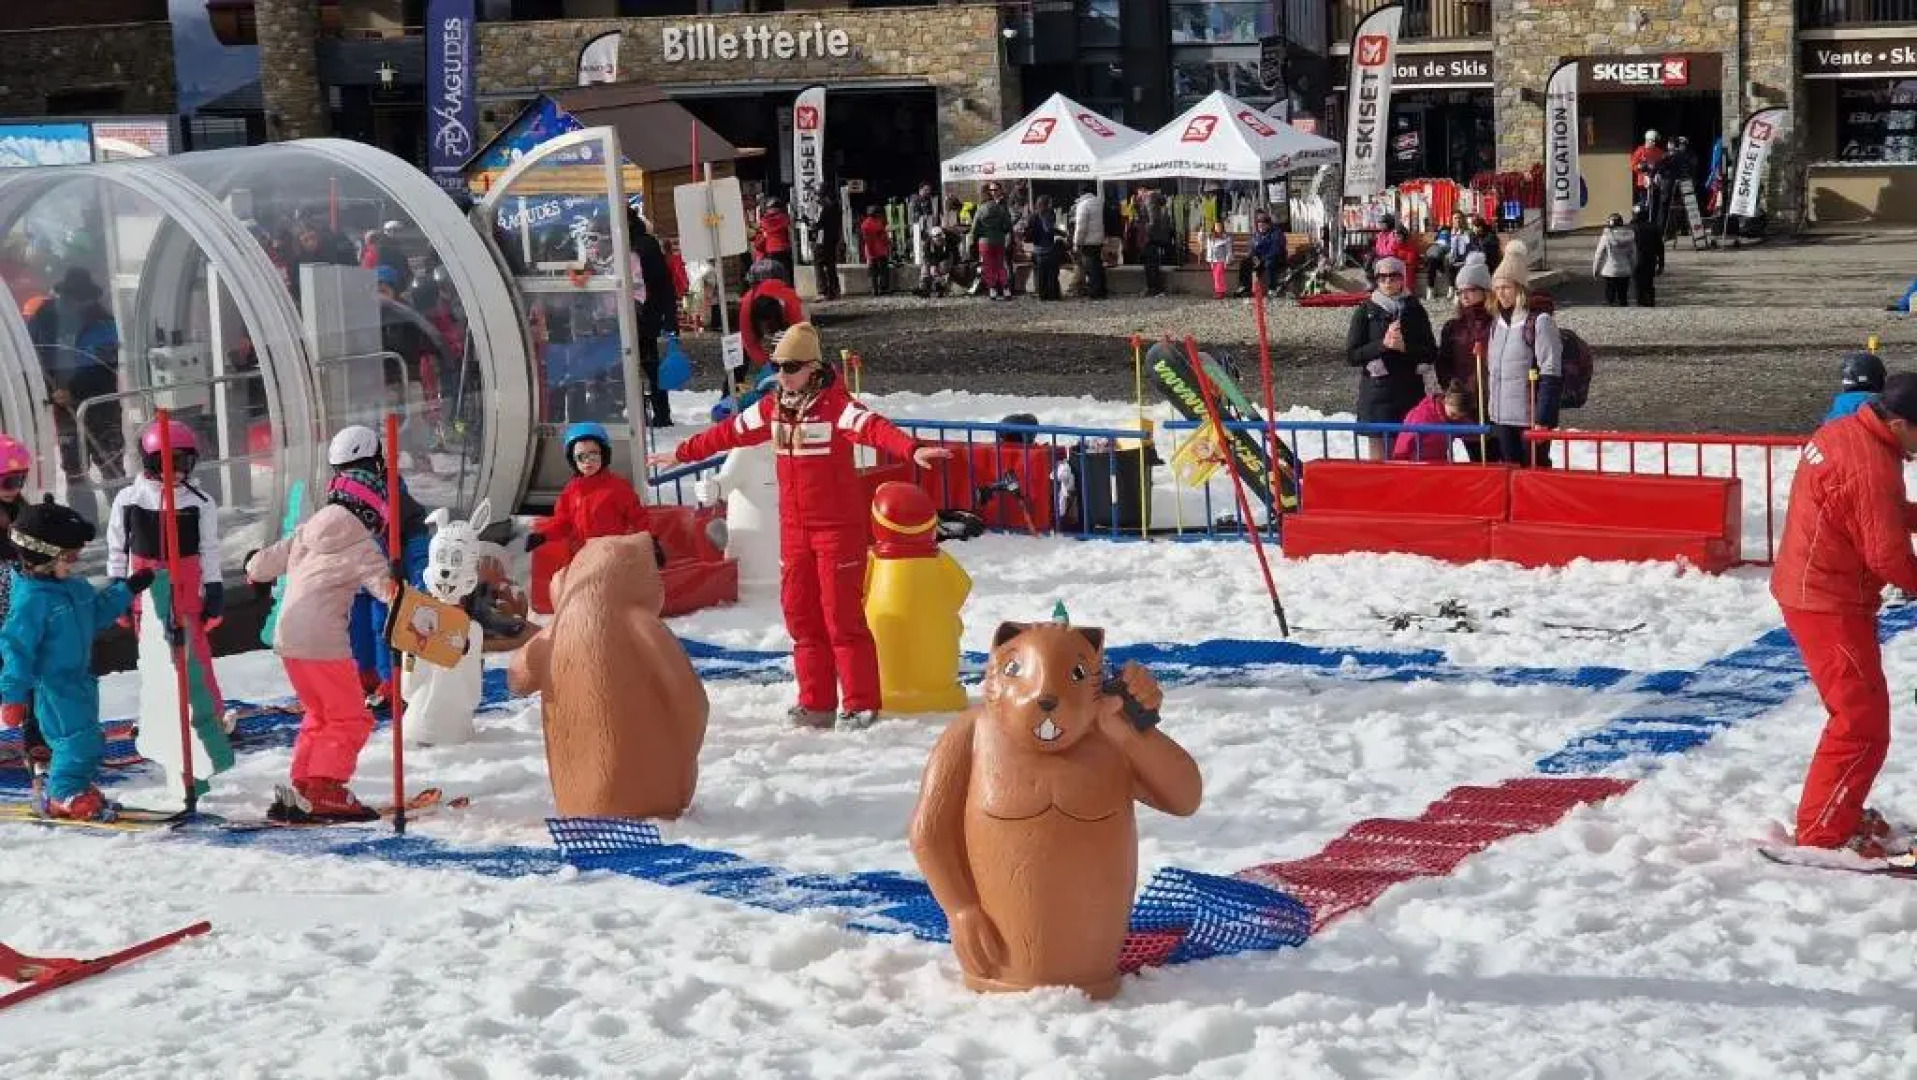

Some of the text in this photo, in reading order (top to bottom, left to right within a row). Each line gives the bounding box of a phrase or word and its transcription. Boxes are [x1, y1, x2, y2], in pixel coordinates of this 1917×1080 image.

[662, 21, 849, 62] Billetterie
[1818, 49, 1873, 65] Vente
[1424, 60, 1446, 77] de
[1451, 59, 1488, 76] Skis
[1592, 63, 1662, 80] SKISET
[1355, 70, 1379, 159] SKISET
[800, 133, 815, 203] SKISET
[1554, 108, 1571, 201] LOCATION
[1739, 142, 1761, 199] SKISET
